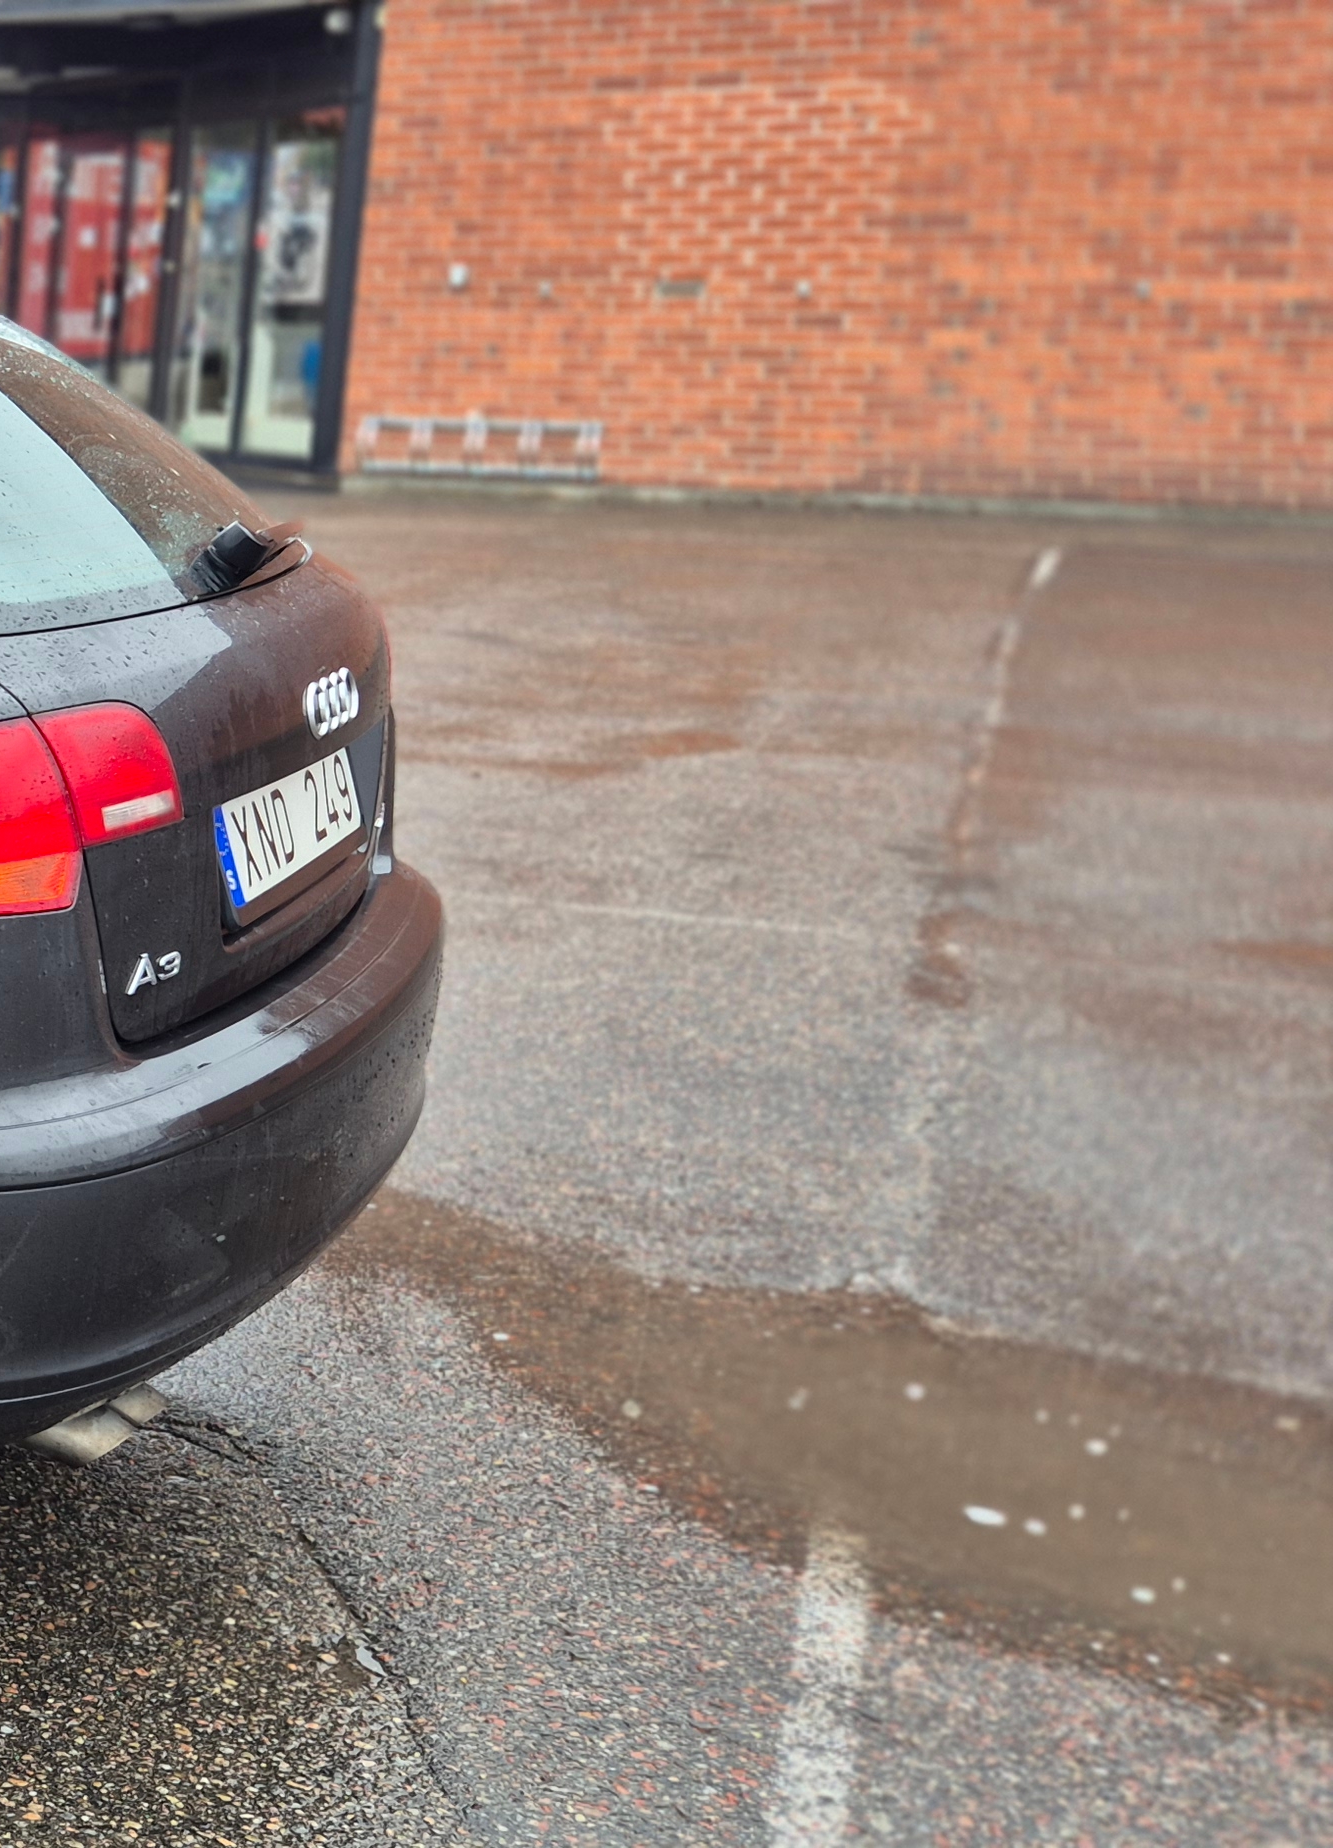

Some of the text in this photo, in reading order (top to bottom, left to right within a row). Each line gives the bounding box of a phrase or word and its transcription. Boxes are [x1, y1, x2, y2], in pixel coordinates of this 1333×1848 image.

[230, 754, 352, 888] XND 249
[225, 869, 237, 891] S
[125, 951, 181, 995] A3
